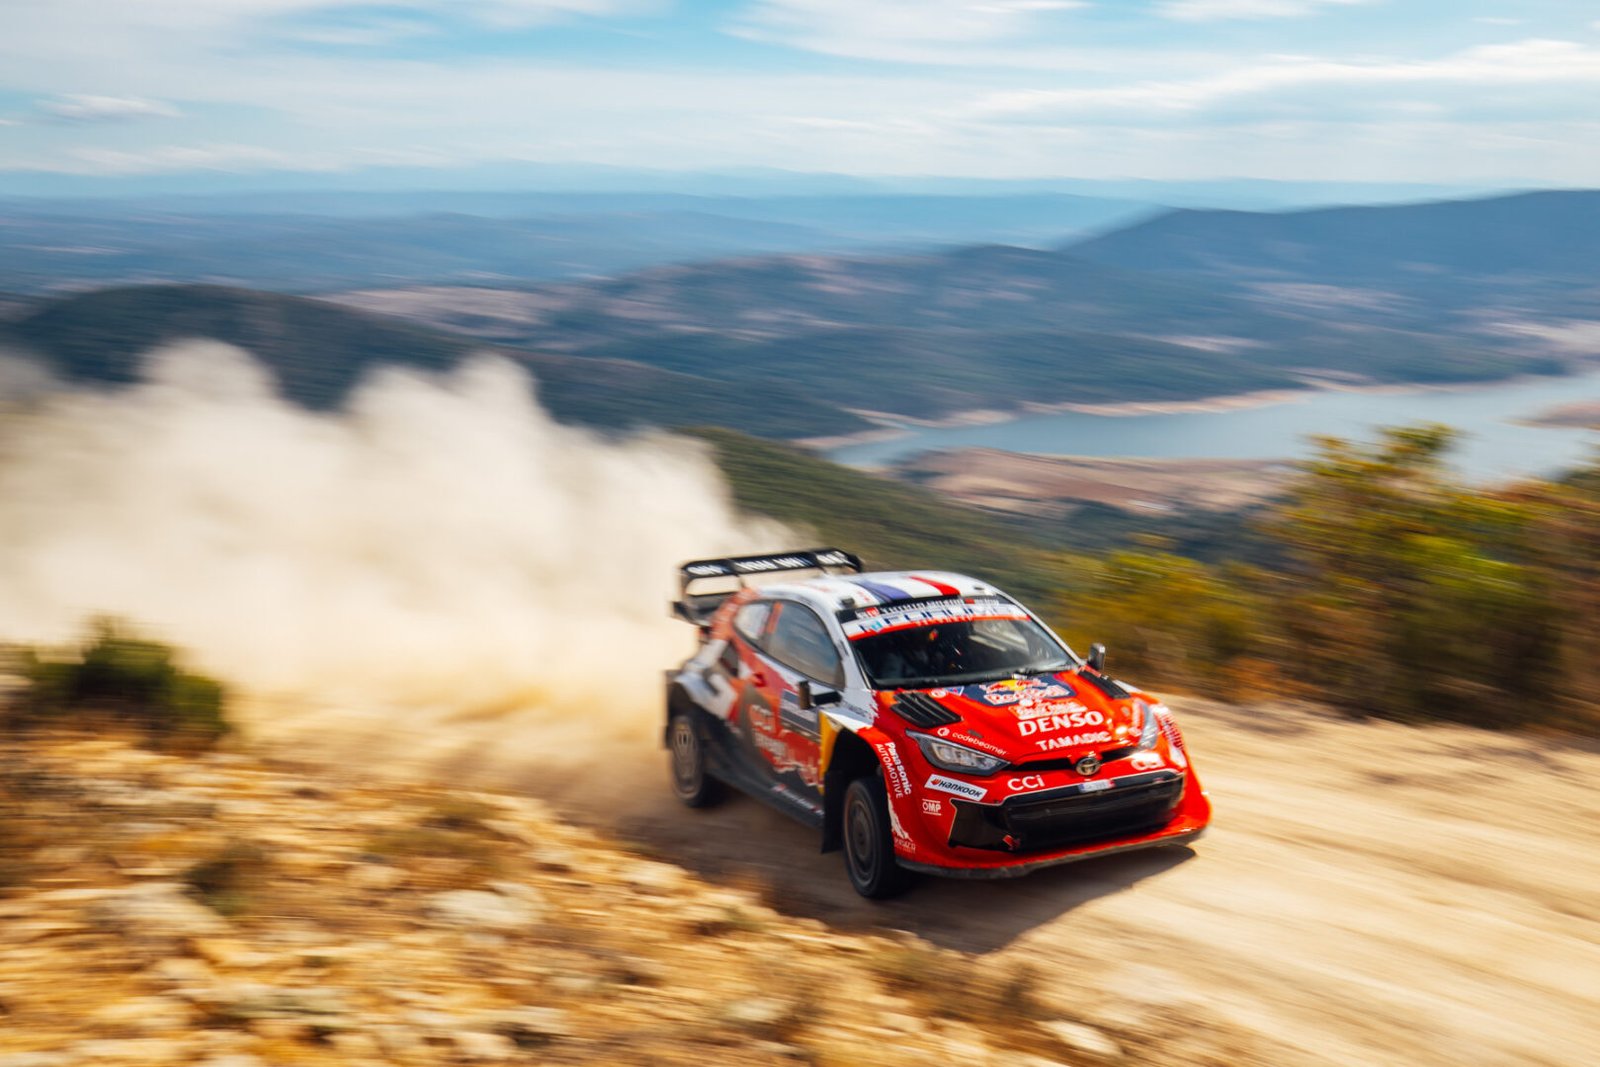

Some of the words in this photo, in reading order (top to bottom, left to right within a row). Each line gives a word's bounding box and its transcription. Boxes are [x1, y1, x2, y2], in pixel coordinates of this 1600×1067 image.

[1017, 711, 1104, 736] DENSO
[952, 732, 1007, 756] codebeamer
[1035, 731, 1112, 751] TAMADIC
[874, 743, 904, 799] AUTOMOTIVE
[885, 742, 912, 795] Panasonic
[1007, 775, 1046, 791] CCi
[922, 801, 942, 813] OMP
